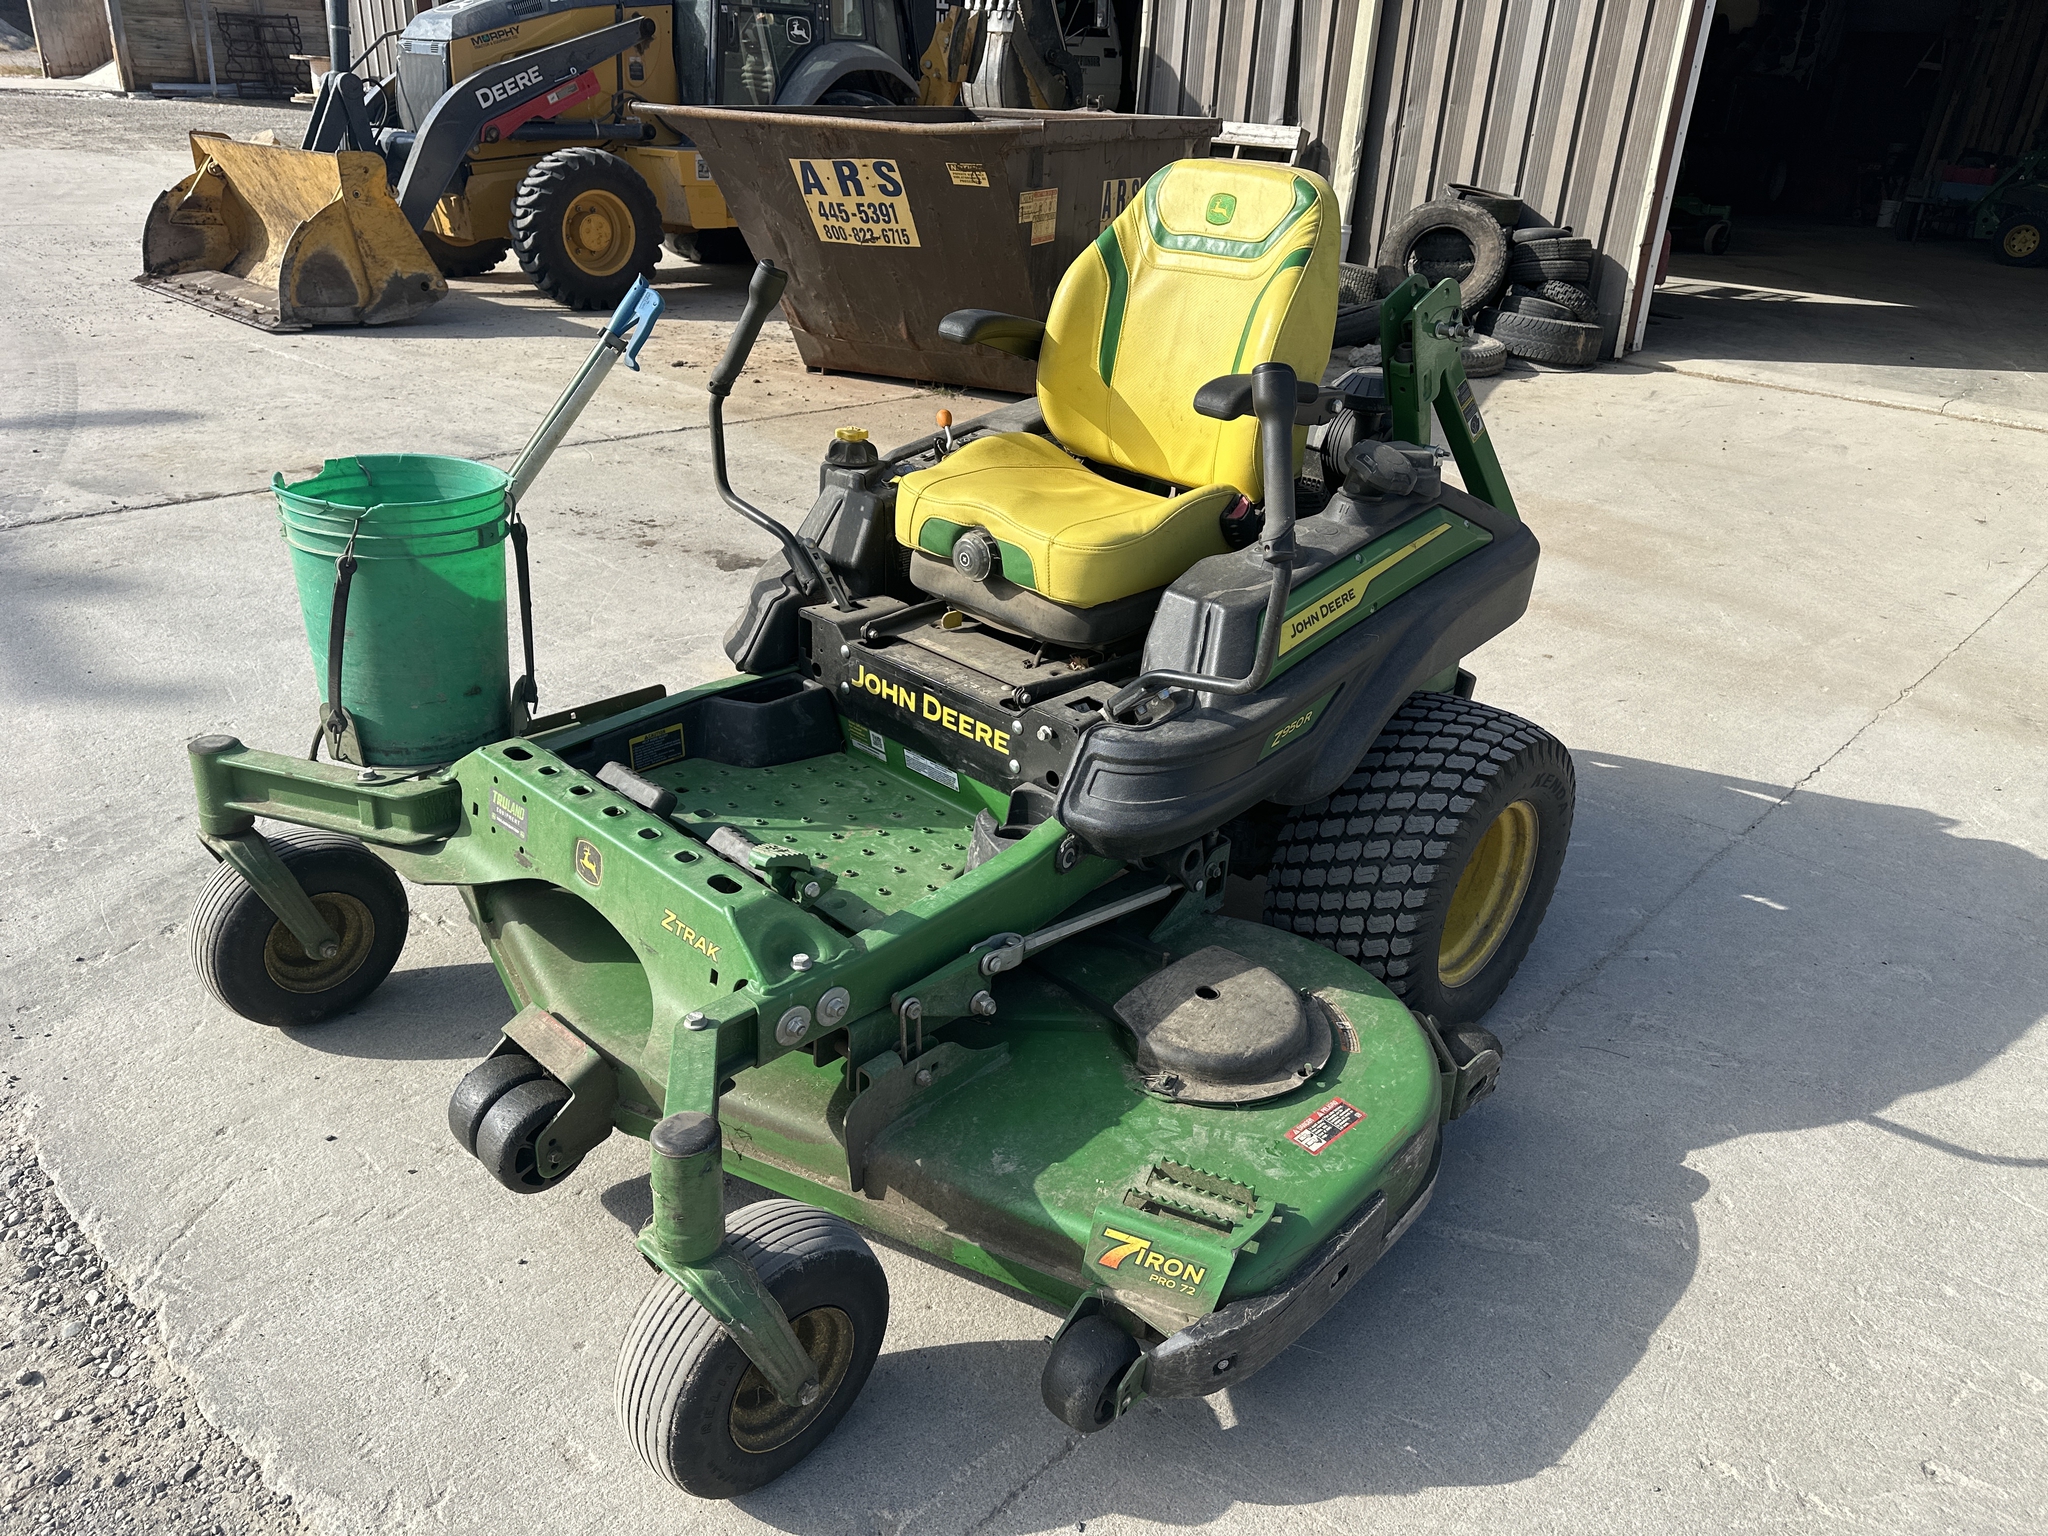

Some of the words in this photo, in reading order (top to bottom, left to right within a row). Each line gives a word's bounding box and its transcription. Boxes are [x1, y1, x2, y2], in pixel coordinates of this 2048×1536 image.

[475, 65, 544, 109] DEERE
[818, 201, 899, 224] 445-5391
[1291, 611, 1320, 639] JOHN
[1319, 588, 1356, 619] DEERE
[851, 664, 916, 713] JOHN
[923, 692, 1011, 756] DEERE
[1270, 710, 1313, 748] Z950R
[1530, 772, 1568, 816] KENDA
[660, 907, 722, 964] ZTRAK
[1148, 1273, 1176, 1289] PRO
[1179, 1283, 1197, 1296] 72
